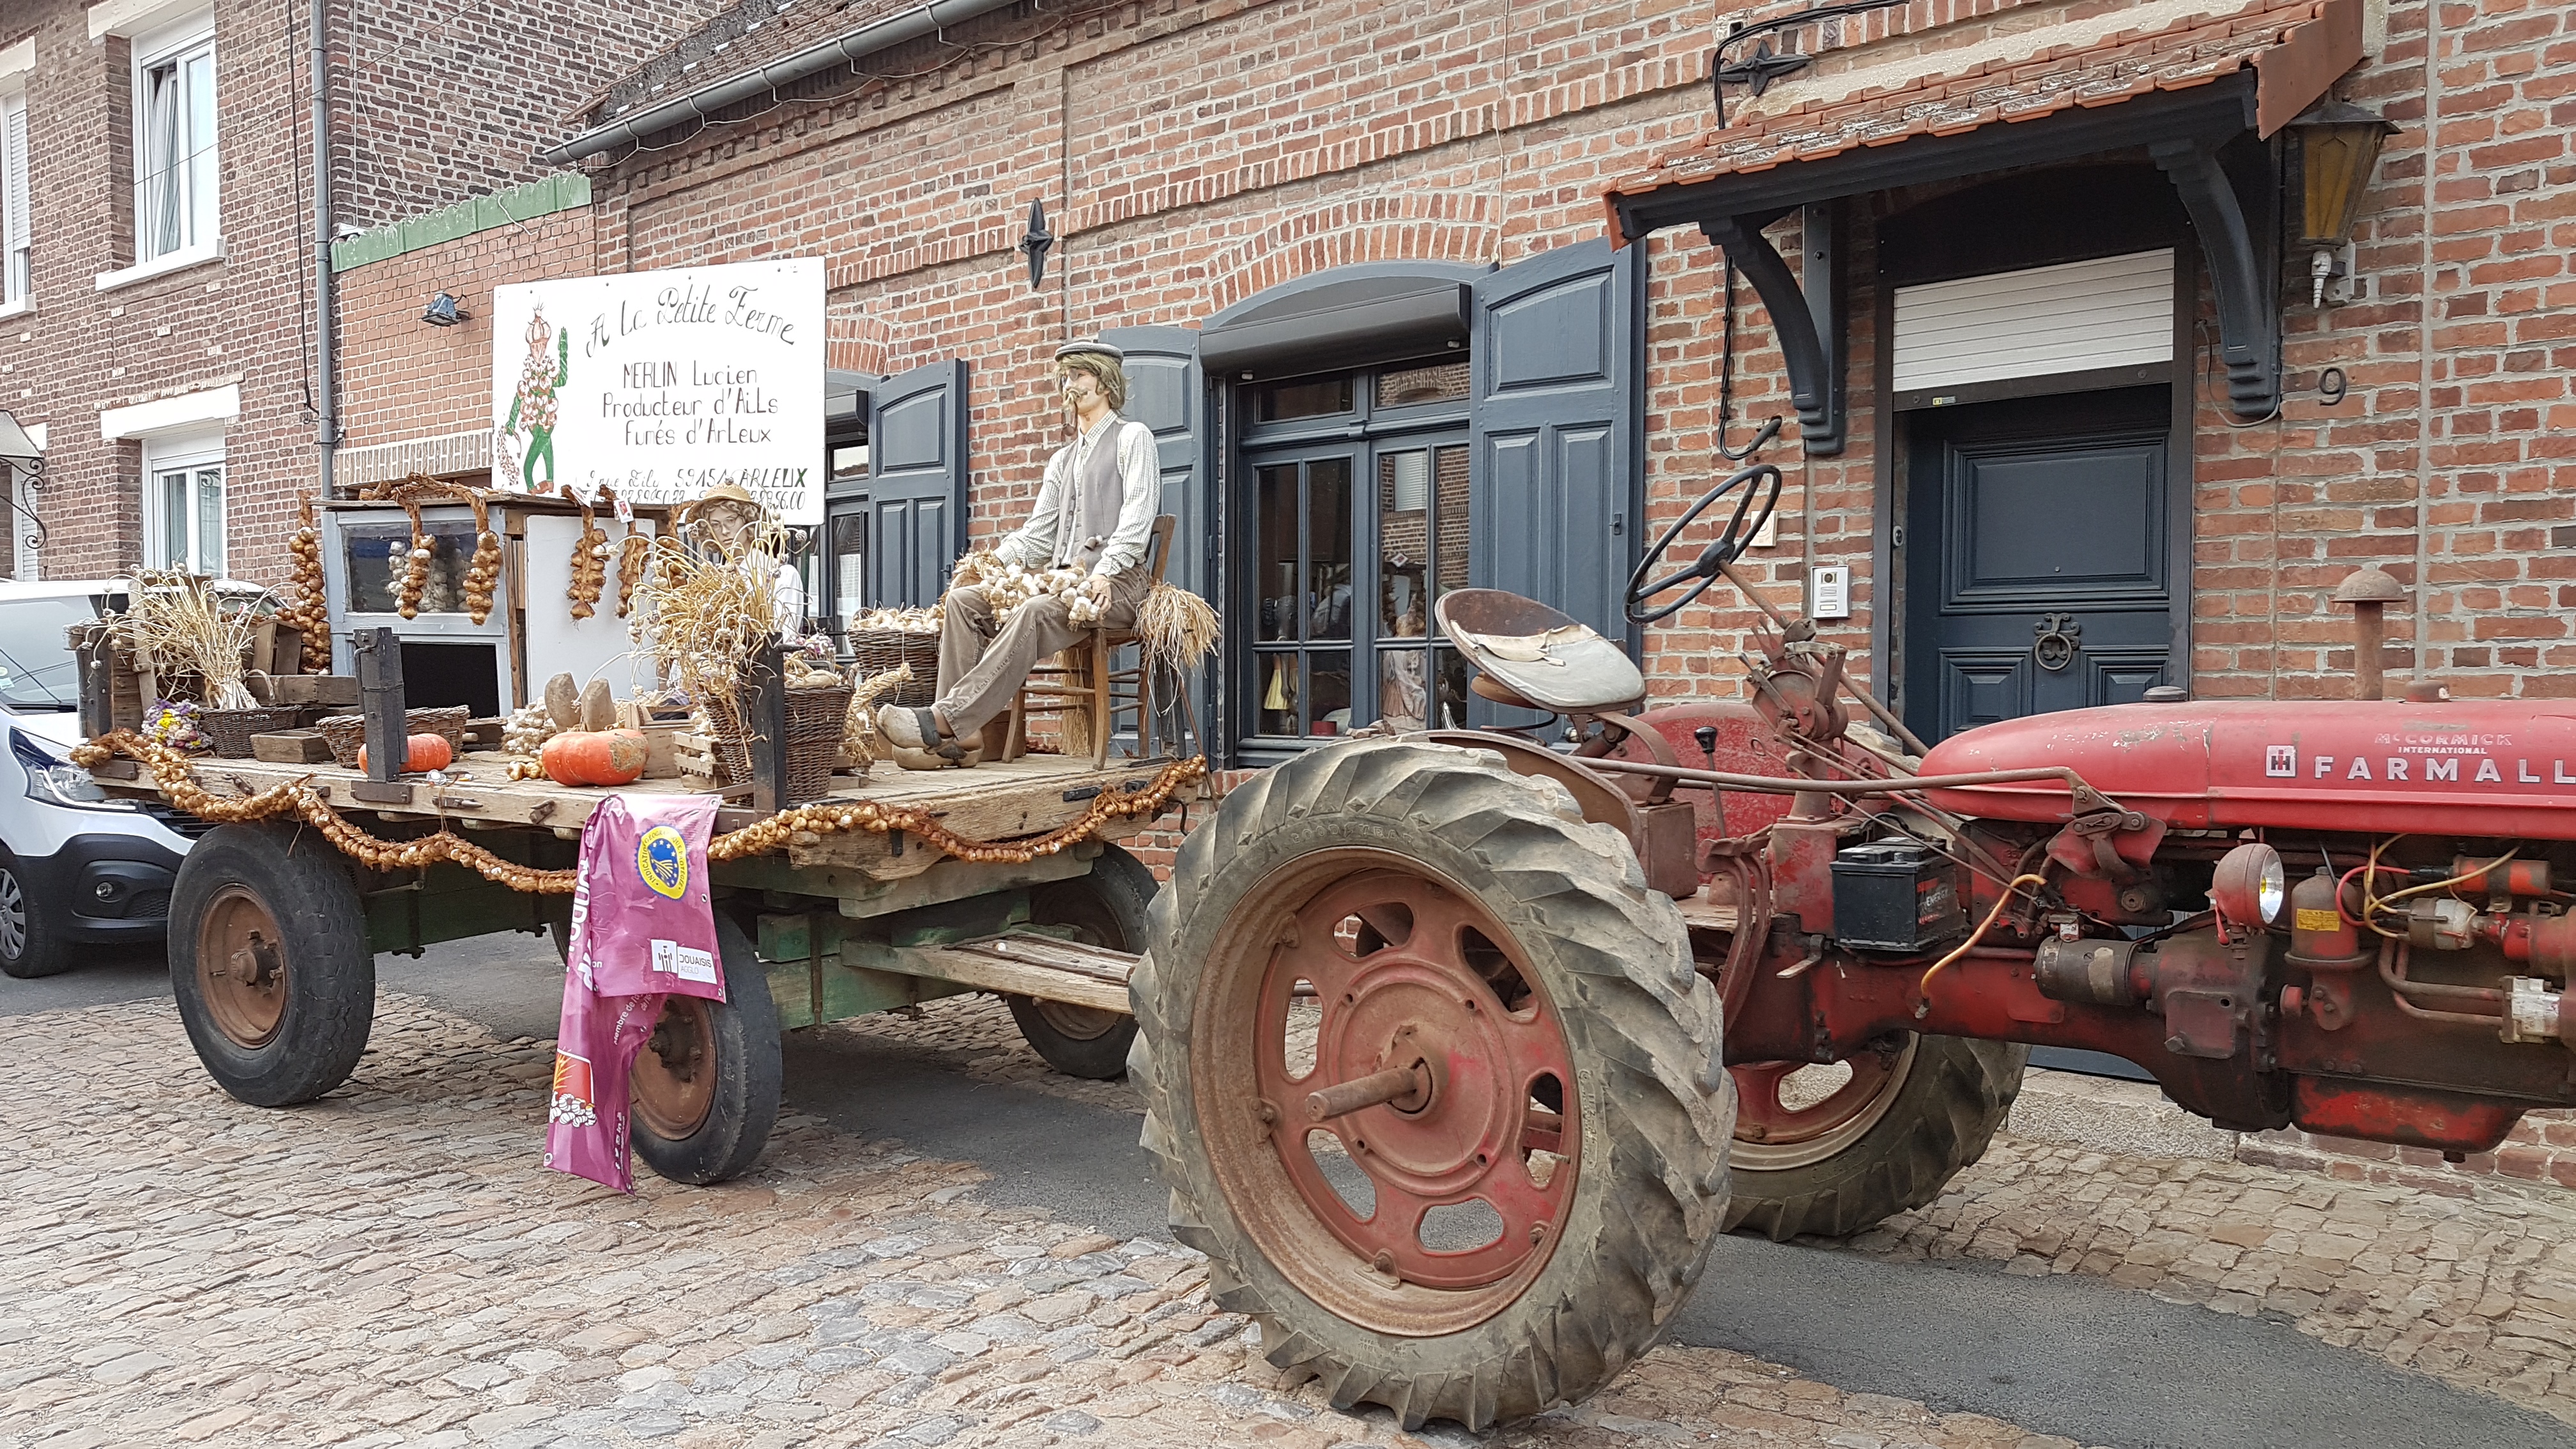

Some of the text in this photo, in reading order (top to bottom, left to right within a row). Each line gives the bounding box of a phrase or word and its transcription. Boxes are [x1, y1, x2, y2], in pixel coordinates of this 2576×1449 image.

[657, 284, 717, 325] Petite
[725, 285, 795, 346] Ferme
[623, 360, 757, 389] MERLIN Lucien
[2319, 367, 2347, 406] 9
[602, 390, 703, 418] Producteur
[739, 468, 809, 488] ARLEUX
[2398, 746, 2488, 755] INTERNATIONAL
[2314, 755, 2576, 784] FARMALL
[678, 954, 712, 968] DOUAISIS
[680, 965, 699, 975] AGGLO
